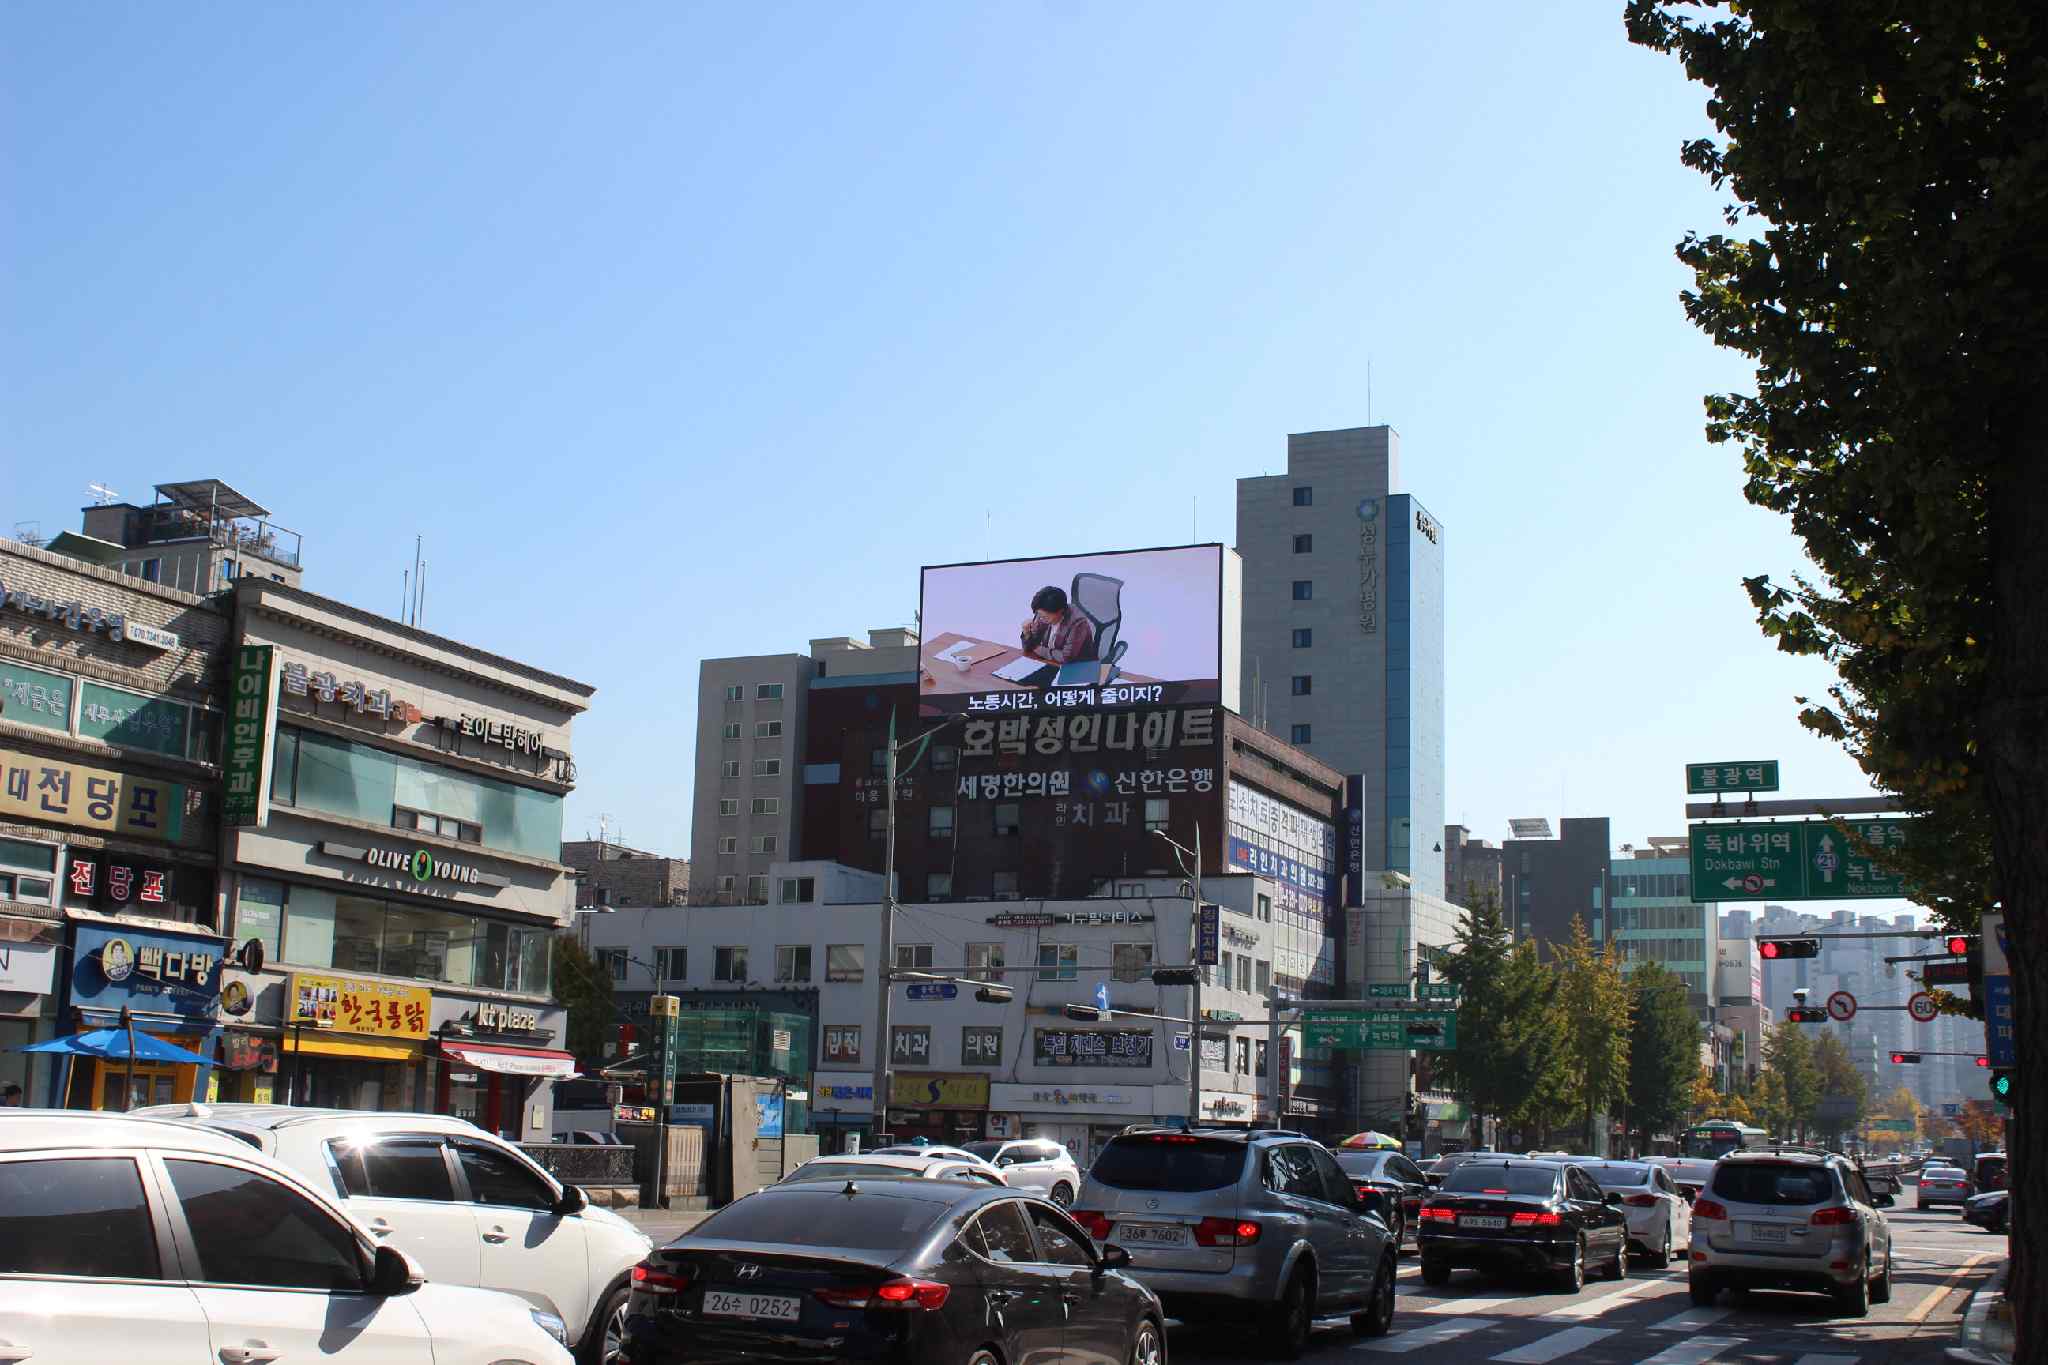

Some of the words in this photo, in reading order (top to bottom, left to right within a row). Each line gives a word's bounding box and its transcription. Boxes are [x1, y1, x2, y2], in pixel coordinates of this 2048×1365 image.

[968, 692, 1038, 710] 노동시간,
[1045, 689, 1095, 707] 어떻게
[1101, 685, 1163, 705] 줄이지?
[229, 651, 266, 792] 나이비인후과
[963, 709, 1214, 757] 호박성인나이트
[958, 771, 1070, 800] 세명한의원
[1114, 768, 1213, 794] 신한은행
[1702, 766, 1763, 786] 불광역
[1072, 803, 1129, 827] 치과
[1704, 832, 1791, 854] 독바위역
[368, 847, 411, 872] OLIVE
[433, 860, 479, 884] YOUNG
[1704, 858, 1755, 871] Dokbawi
[1761, 857, 1780, 870] Stn
[70, 860, 165, 903] 전당포
[138, 945, 214, 986] 빽다방
[478, 1001, 496, 1027] kt
[498, 1005, 536, 1033] plaza
[895, 1031, 928, 1056] 치과
[968, 1034, 998, 1056] 의원
[1111, 1034, 1152, 1056] 보청기
[750, 1297, 792, 1317] 0252
